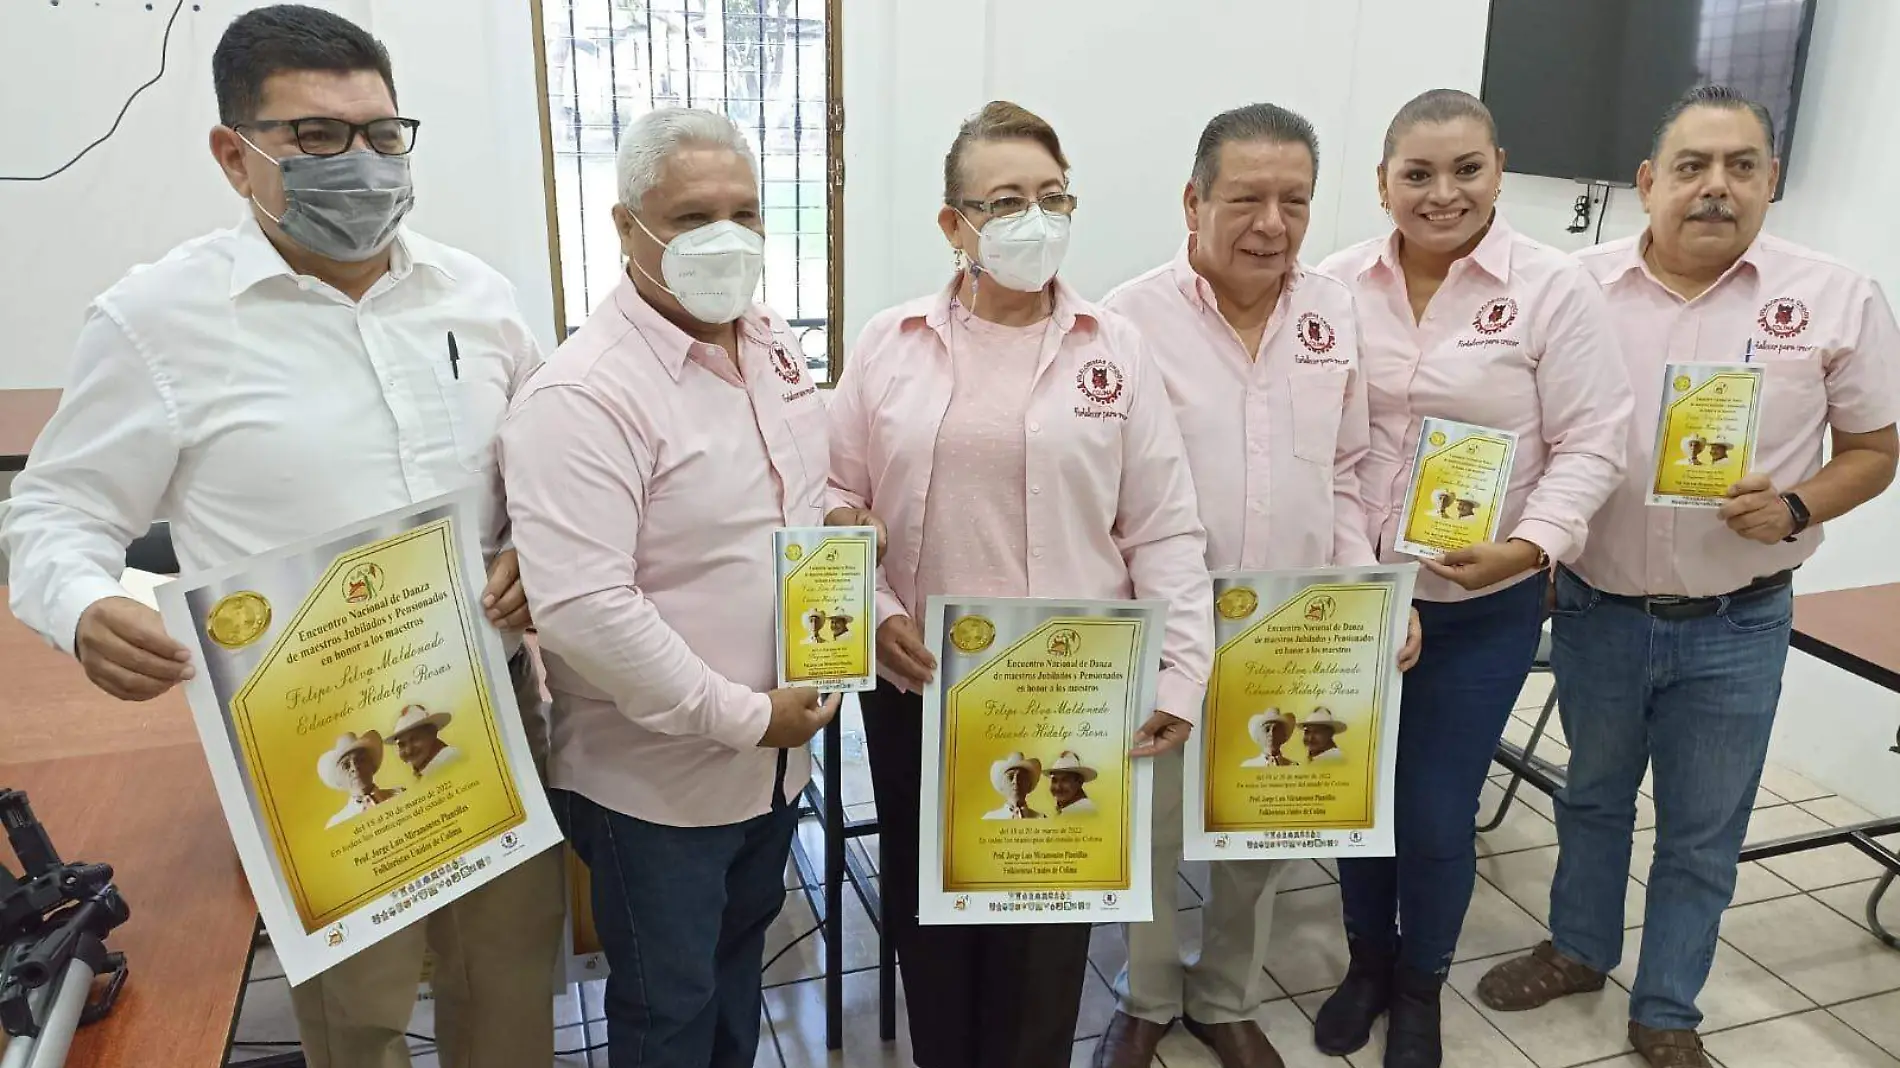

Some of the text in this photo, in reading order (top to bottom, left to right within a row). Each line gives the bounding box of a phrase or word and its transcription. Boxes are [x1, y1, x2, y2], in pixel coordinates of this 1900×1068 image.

[287, 590, 448, 664] de maestros Jubilados y Pensionados
[298, 583, 430, 642] Encuentro Nacional de Danza
[321, 617, 424, 666] en honor a los maestros
[286, 631, 445, 710] Felipe Silva Maldonado
[994, 672, 1003, 680] de
[1038, 671, 1072, 680] Jubilados
[1073, 674, 1077, 682] y
[1080, 671, 1123, 680] Pensionados
[1007, 659, 1112, 668] Encuentro Nacional de Danza
[297, 662, 451, 735] Eduardo Hidalgo Rosas
[1027, 684, 1047, 693] honor
[1056, 684, 1066, 693] los
[984, 700, 1110, 720] Felipe Silva Maldonado
[984, 722, 1108, 742] Eduardo Hidalgo Rosas
